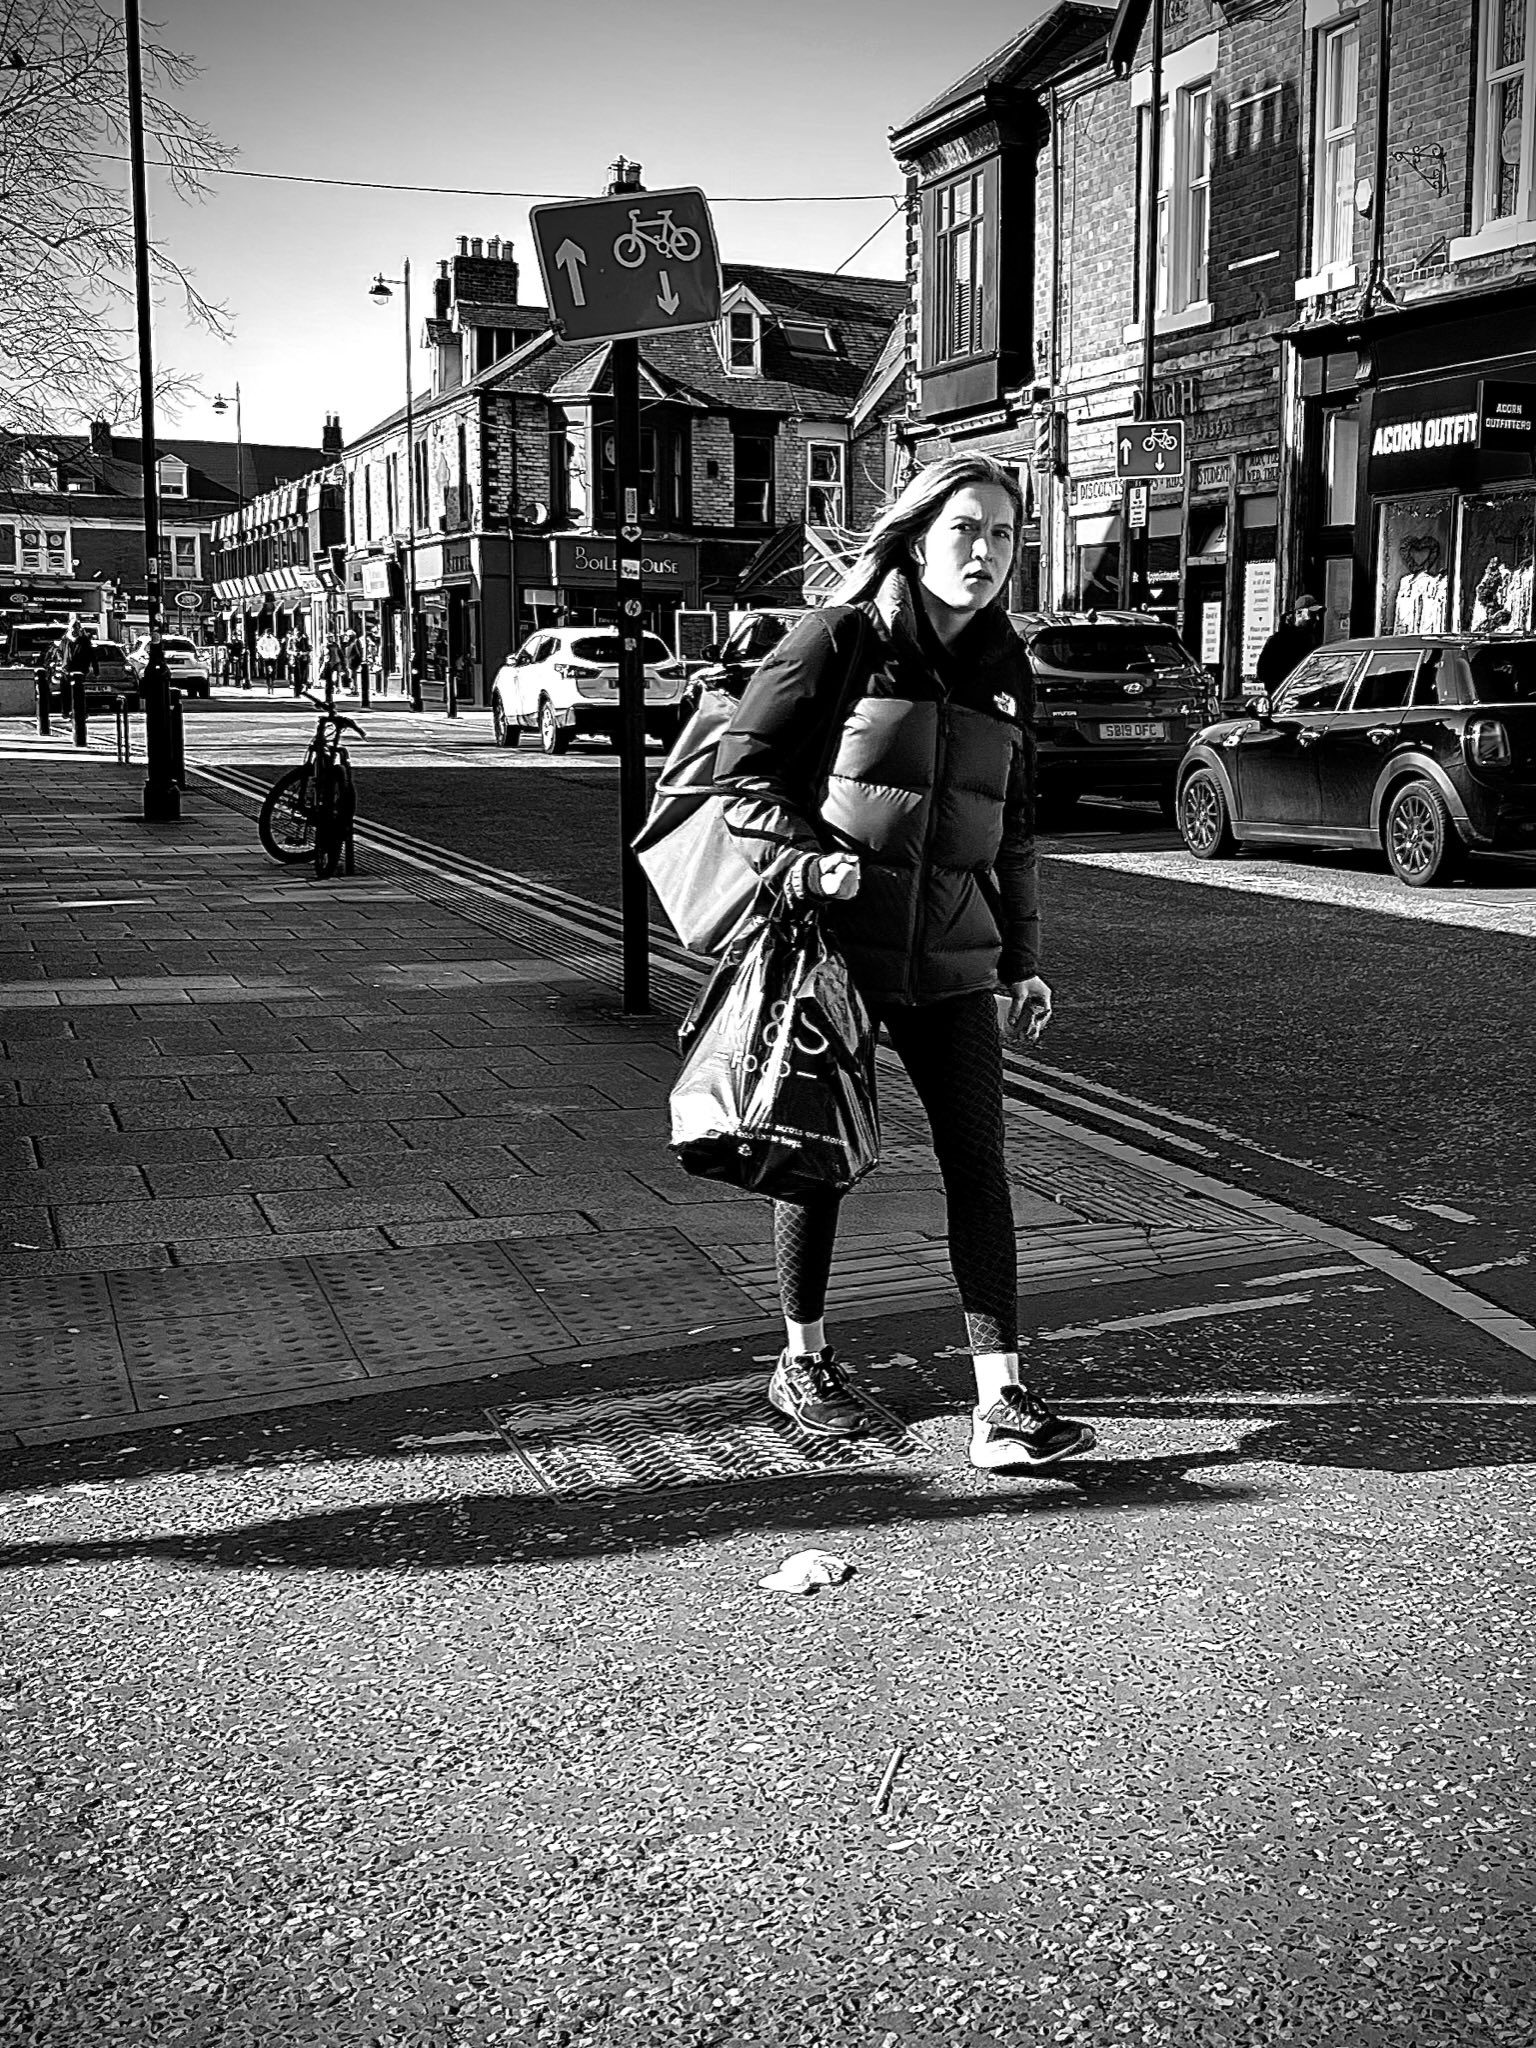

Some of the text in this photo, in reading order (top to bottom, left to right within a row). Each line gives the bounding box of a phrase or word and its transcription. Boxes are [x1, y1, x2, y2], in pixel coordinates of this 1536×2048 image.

[1495, 403, 1522, 415] ACORN
[1485, 418, 1531, 431] OUTFITTERS
[1372, 412, 1478, 456] ACORN OUTFIT
[575, 546, 679, 574] BOILE OUSE
[1106, 724, 1157, 737] SB19 OFC
[775, 1124, 803, 1136] across
[805, 1131, 820, 1139] our
[823, 1135, 848, 1147] stores
